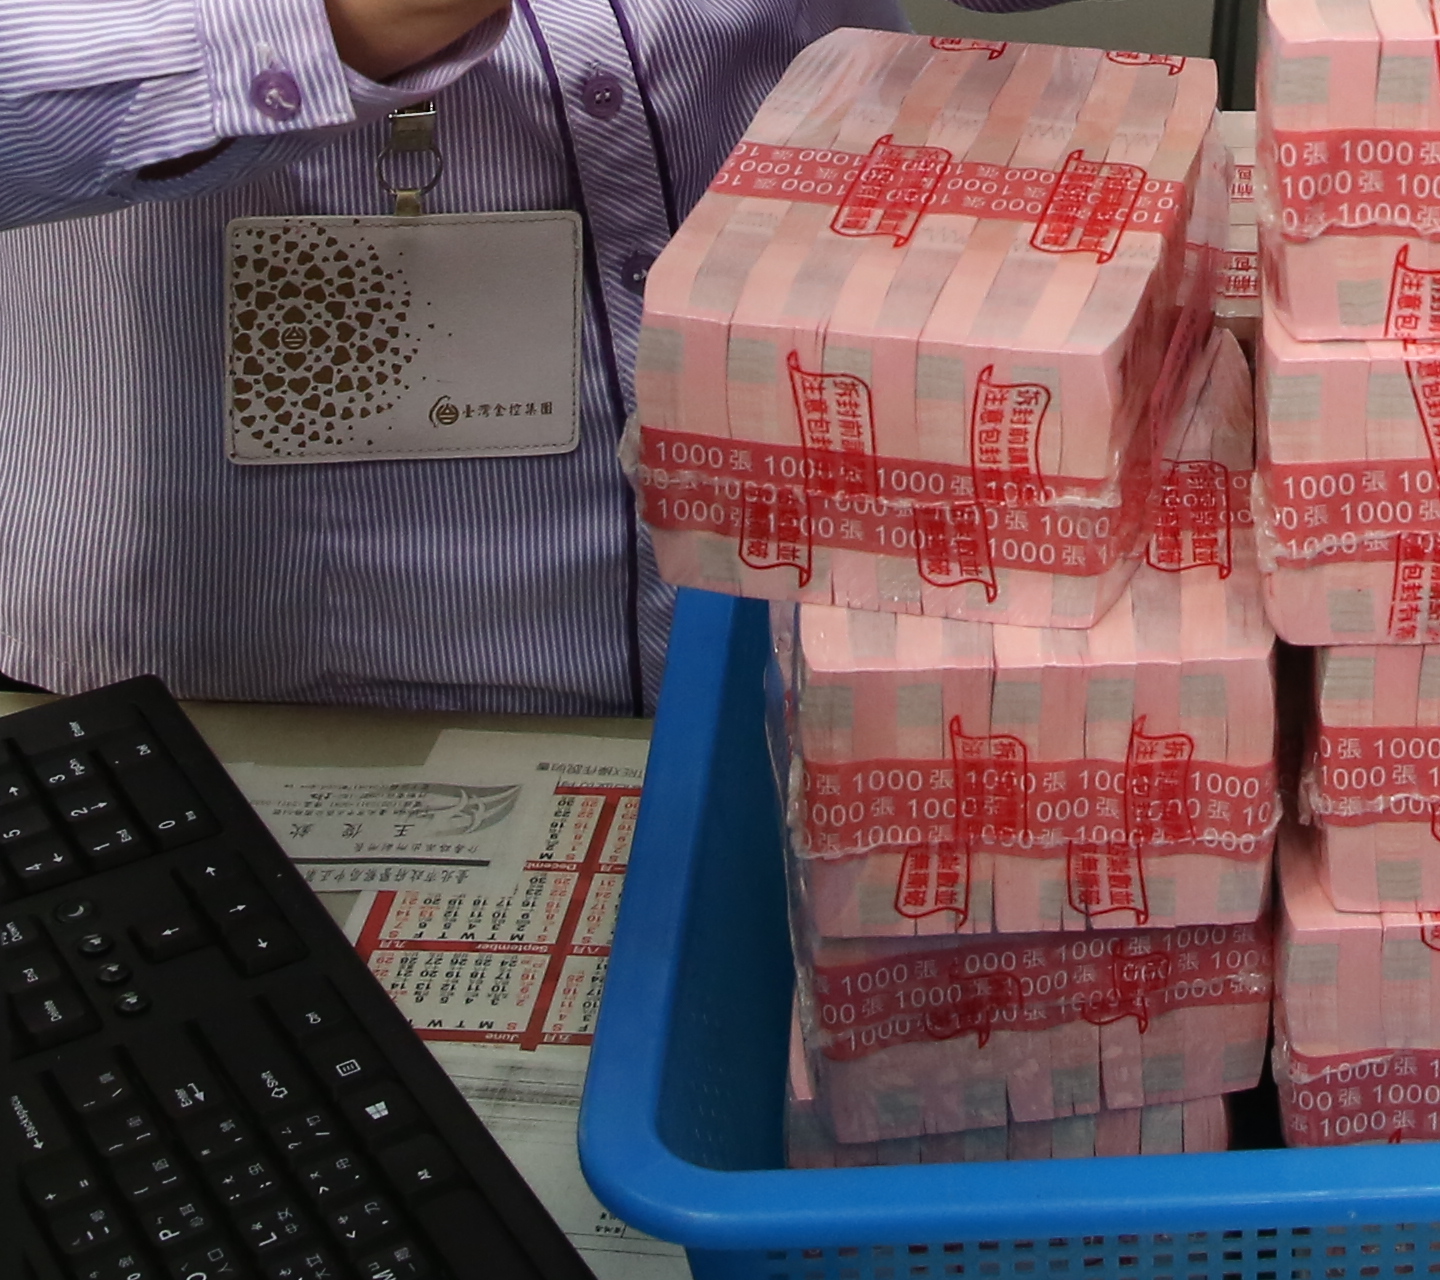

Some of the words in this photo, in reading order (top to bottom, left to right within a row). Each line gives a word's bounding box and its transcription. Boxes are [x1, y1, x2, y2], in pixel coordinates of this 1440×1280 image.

[1283, 172, 1351, 198] 1000
[1360, 171, 1383, 193] 張
[462, 402, 553, 419] 臺灣金控集團
[1284, 473, 1355, 500] 1000
[1363, 470, 1386, 493] 張
[1305, 505, 1328, 528] 張
[1341, 500, 1413, 524] 1000
[49, 774, 65, 783] 3
[817, 774, 841, 797] 張
[851, 770, 923, 793] 1000
[929, 769, 954, 791] 張
[71, 807, 88, 817] 2
[158, 820, 175, 829] 0
[3, 829, 21, 838] 5
[25, 863, 42, 871] 4
[379, 940, 405, 948] 九月
[475, 944, 548, 952] September
[465, 997, 474, 1005] 4
[491, 998, 499, 1006] 3
[455, 1020, 465, 1028] T
[479, 1021, 494, 1029] M
[507, 1022, 518, 1030] S
[485, 1032, 519, 1041] June
[1372, 1084, 1440, 1106] 1000
